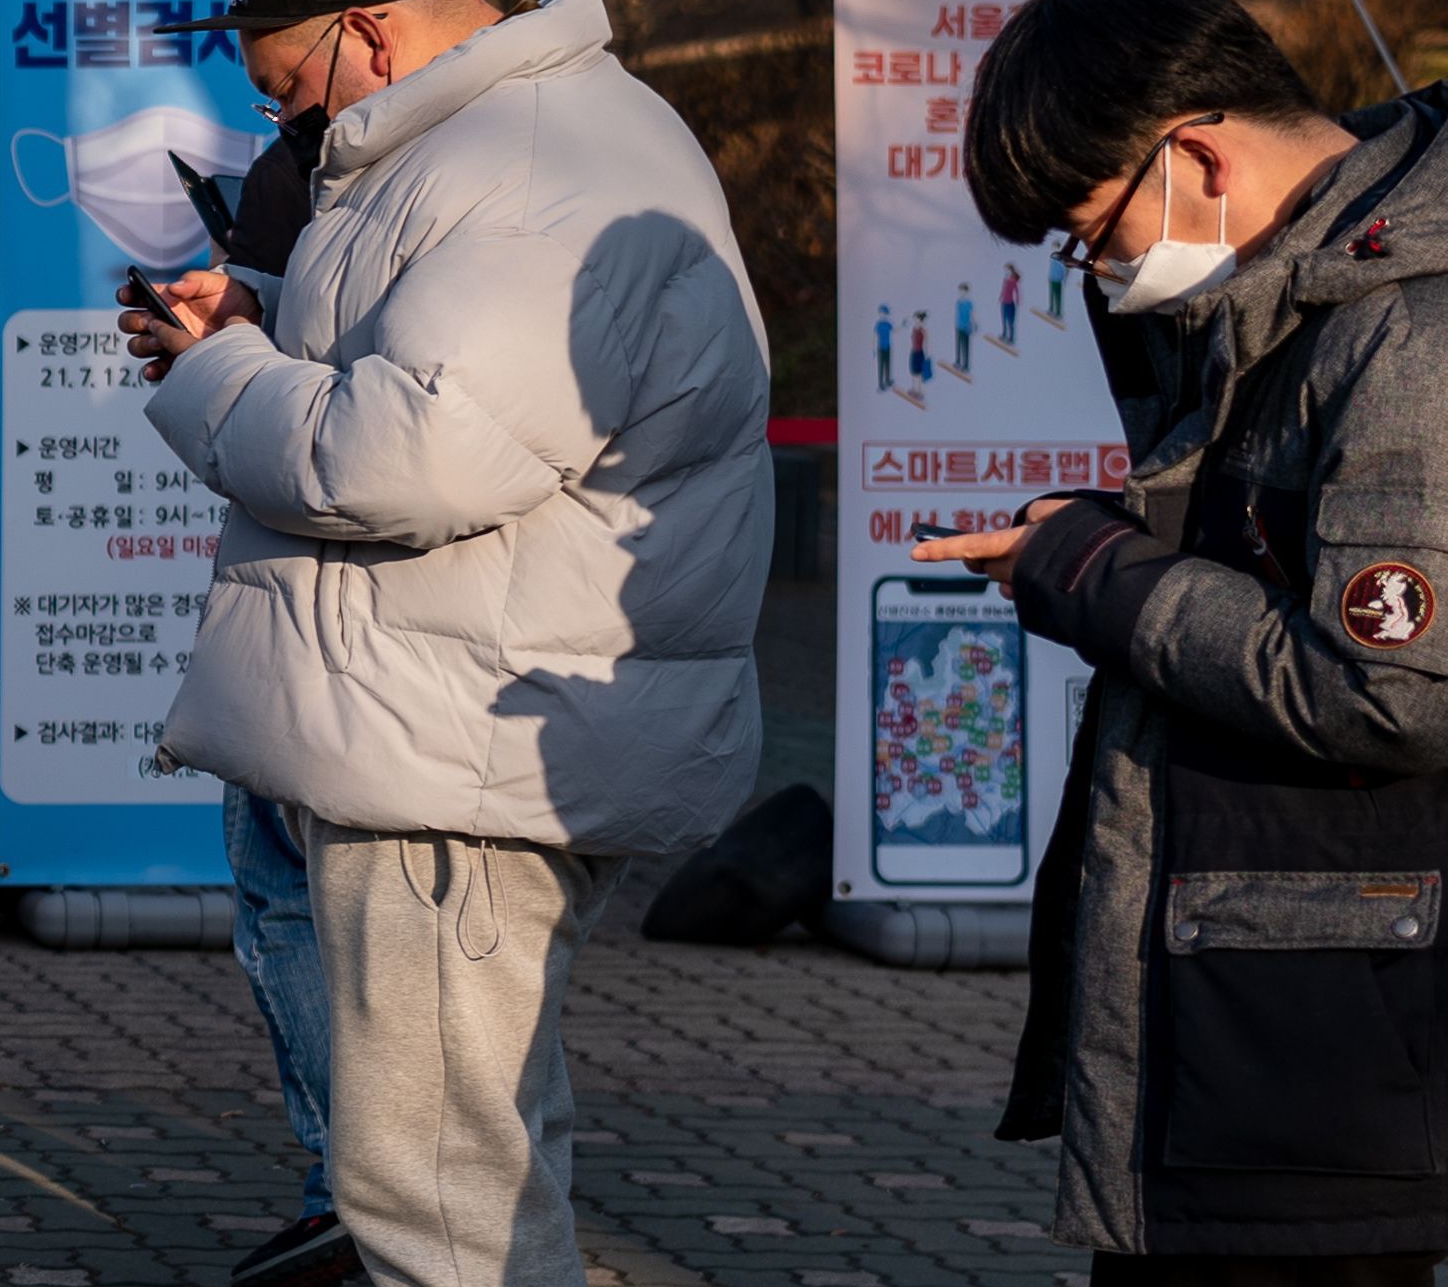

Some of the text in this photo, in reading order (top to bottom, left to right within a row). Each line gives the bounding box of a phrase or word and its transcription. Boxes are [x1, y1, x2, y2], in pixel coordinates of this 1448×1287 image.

[931, 4, 1016, 40] 서울
[853, 51, 961, 85] 코로나
[38, 331, 120, 355] 운영기간
[38, 436, 120, 459] 운영시간
[871, 450, 1090, 485] 스마트서울맵
[34, 470, 54, 494] 평
[107, 535, 175, 559] (일요일
[37, 594, 119, 616] 대기자가
[124, 594, 165, 617] 많은
[36, 623, 156, 646] 접수마감으로
[35, 652, 75, 676] 단축
[82, 652, 142, 675] 운영될
[149, 652, 168, 675] 수
